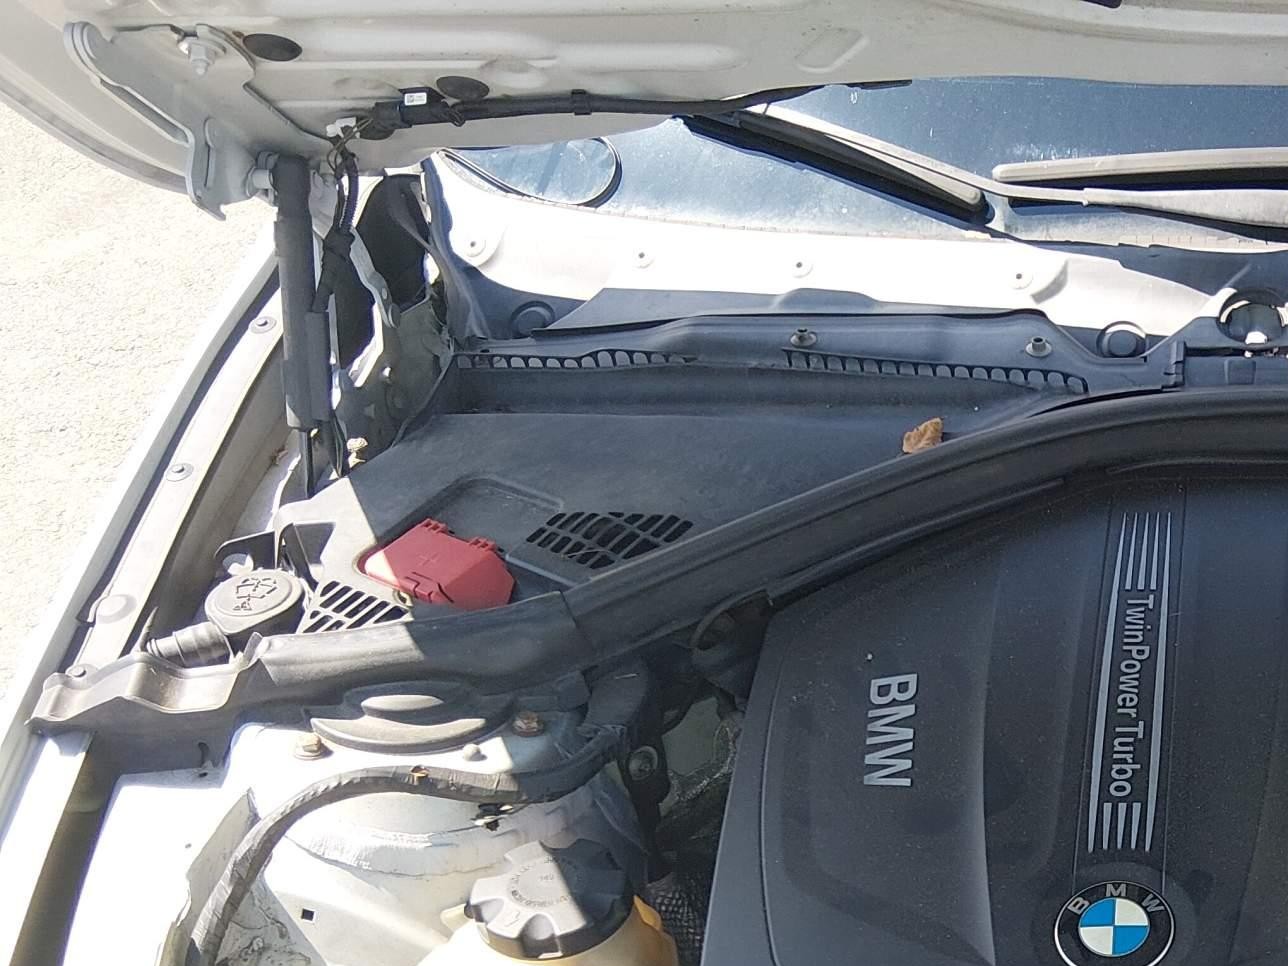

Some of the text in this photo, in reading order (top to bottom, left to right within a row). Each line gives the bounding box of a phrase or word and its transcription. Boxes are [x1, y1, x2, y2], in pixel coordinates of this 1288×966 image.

[863, 673, 918, 787] BMW
[1109, 594, 1155, 798] TwinPower Turbo
[1067, 883, 1165, 915] BMW
